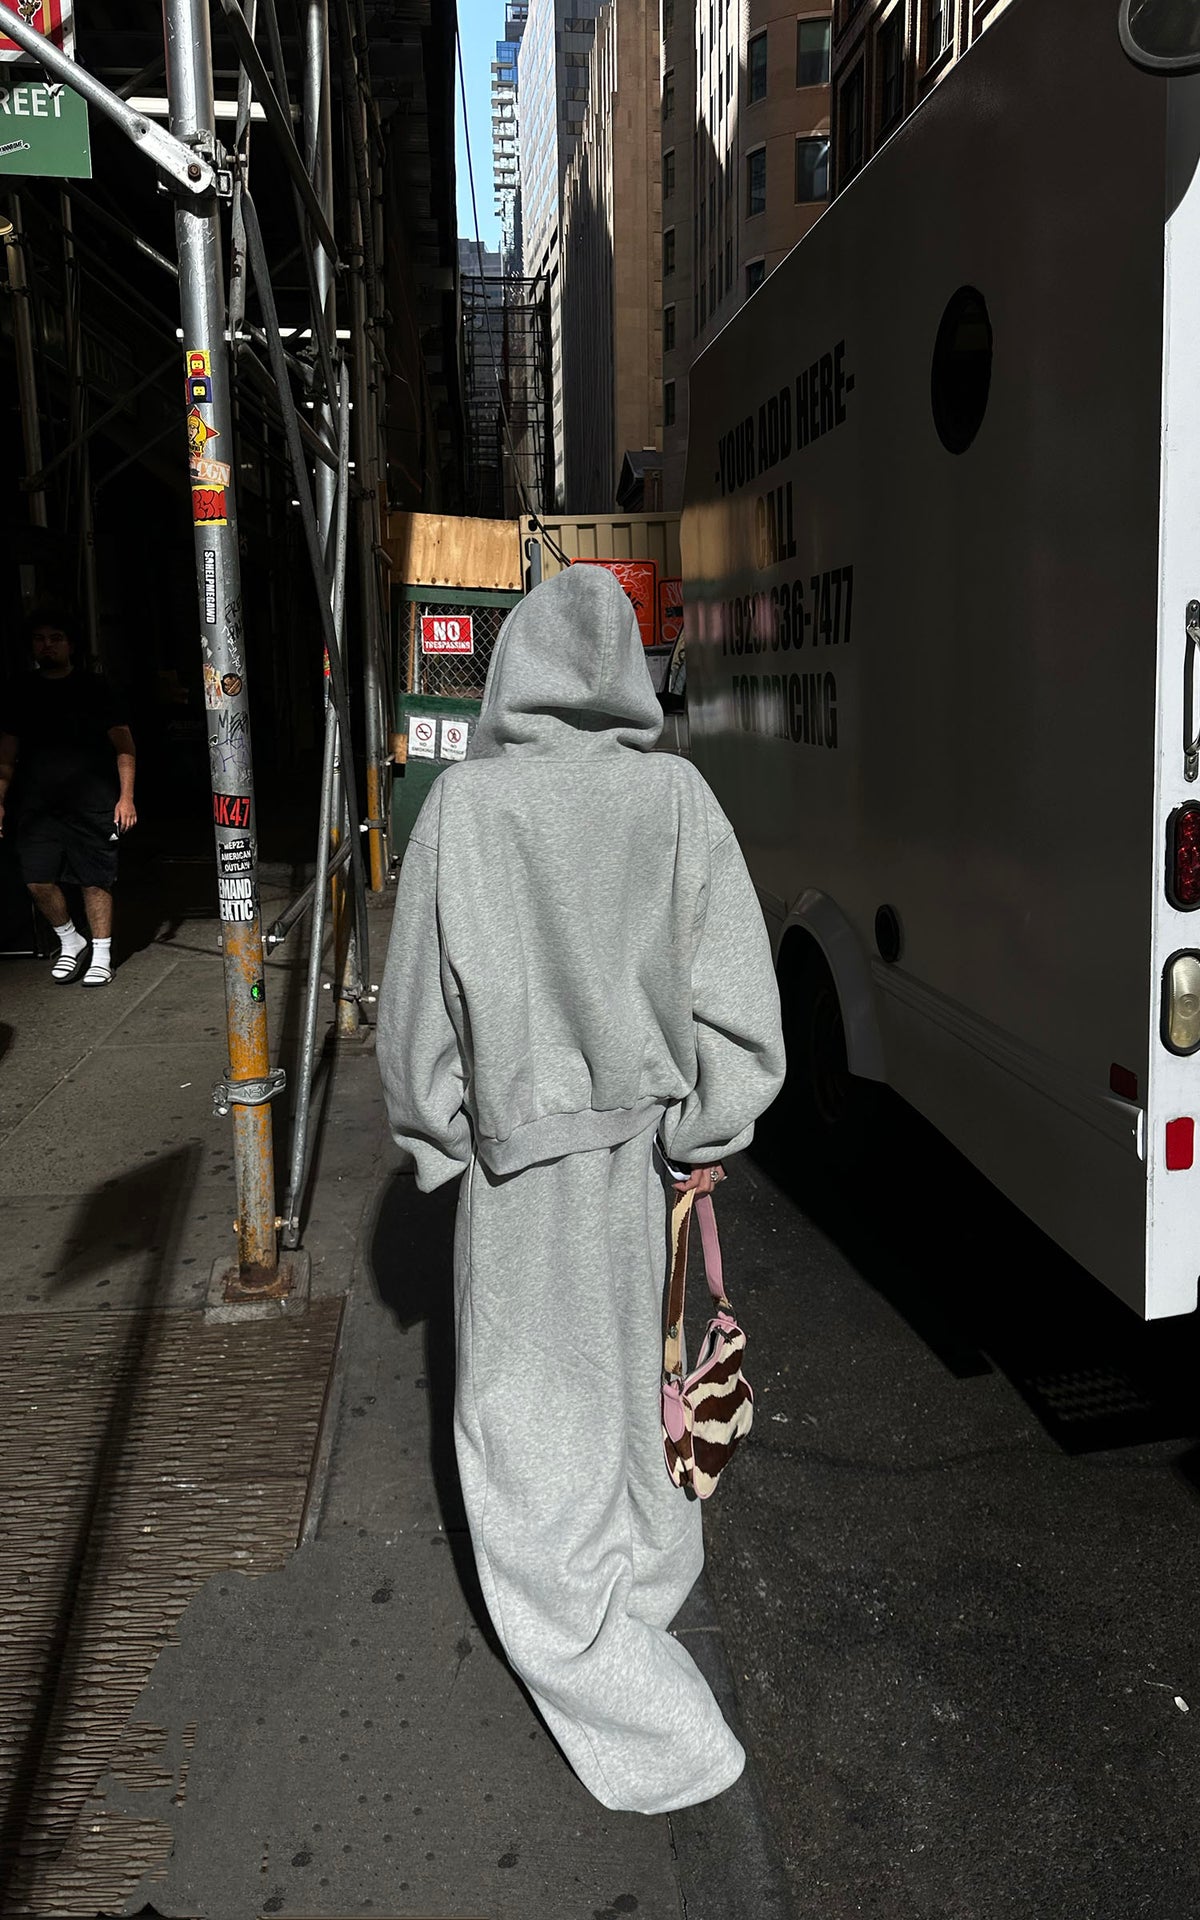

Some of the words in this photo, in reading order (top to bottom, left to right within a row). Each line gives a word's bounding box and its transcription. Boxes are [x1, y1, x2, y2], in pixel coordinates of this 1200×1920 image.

[758, 386, 792, 475] ADD
[755, 481, 797, 570] CALL
[433, 621, 460, 641] NO
[424, 641, 470, 649] TRESPASSING
[732, 674, 759, 732] FOR
[763, 671, 838, 749] PRICING
[213, 794, 250, 827] AK47
[221, 850, 252, 861] AMERICAN
[224, 861, 251, 872] OUTLAW
